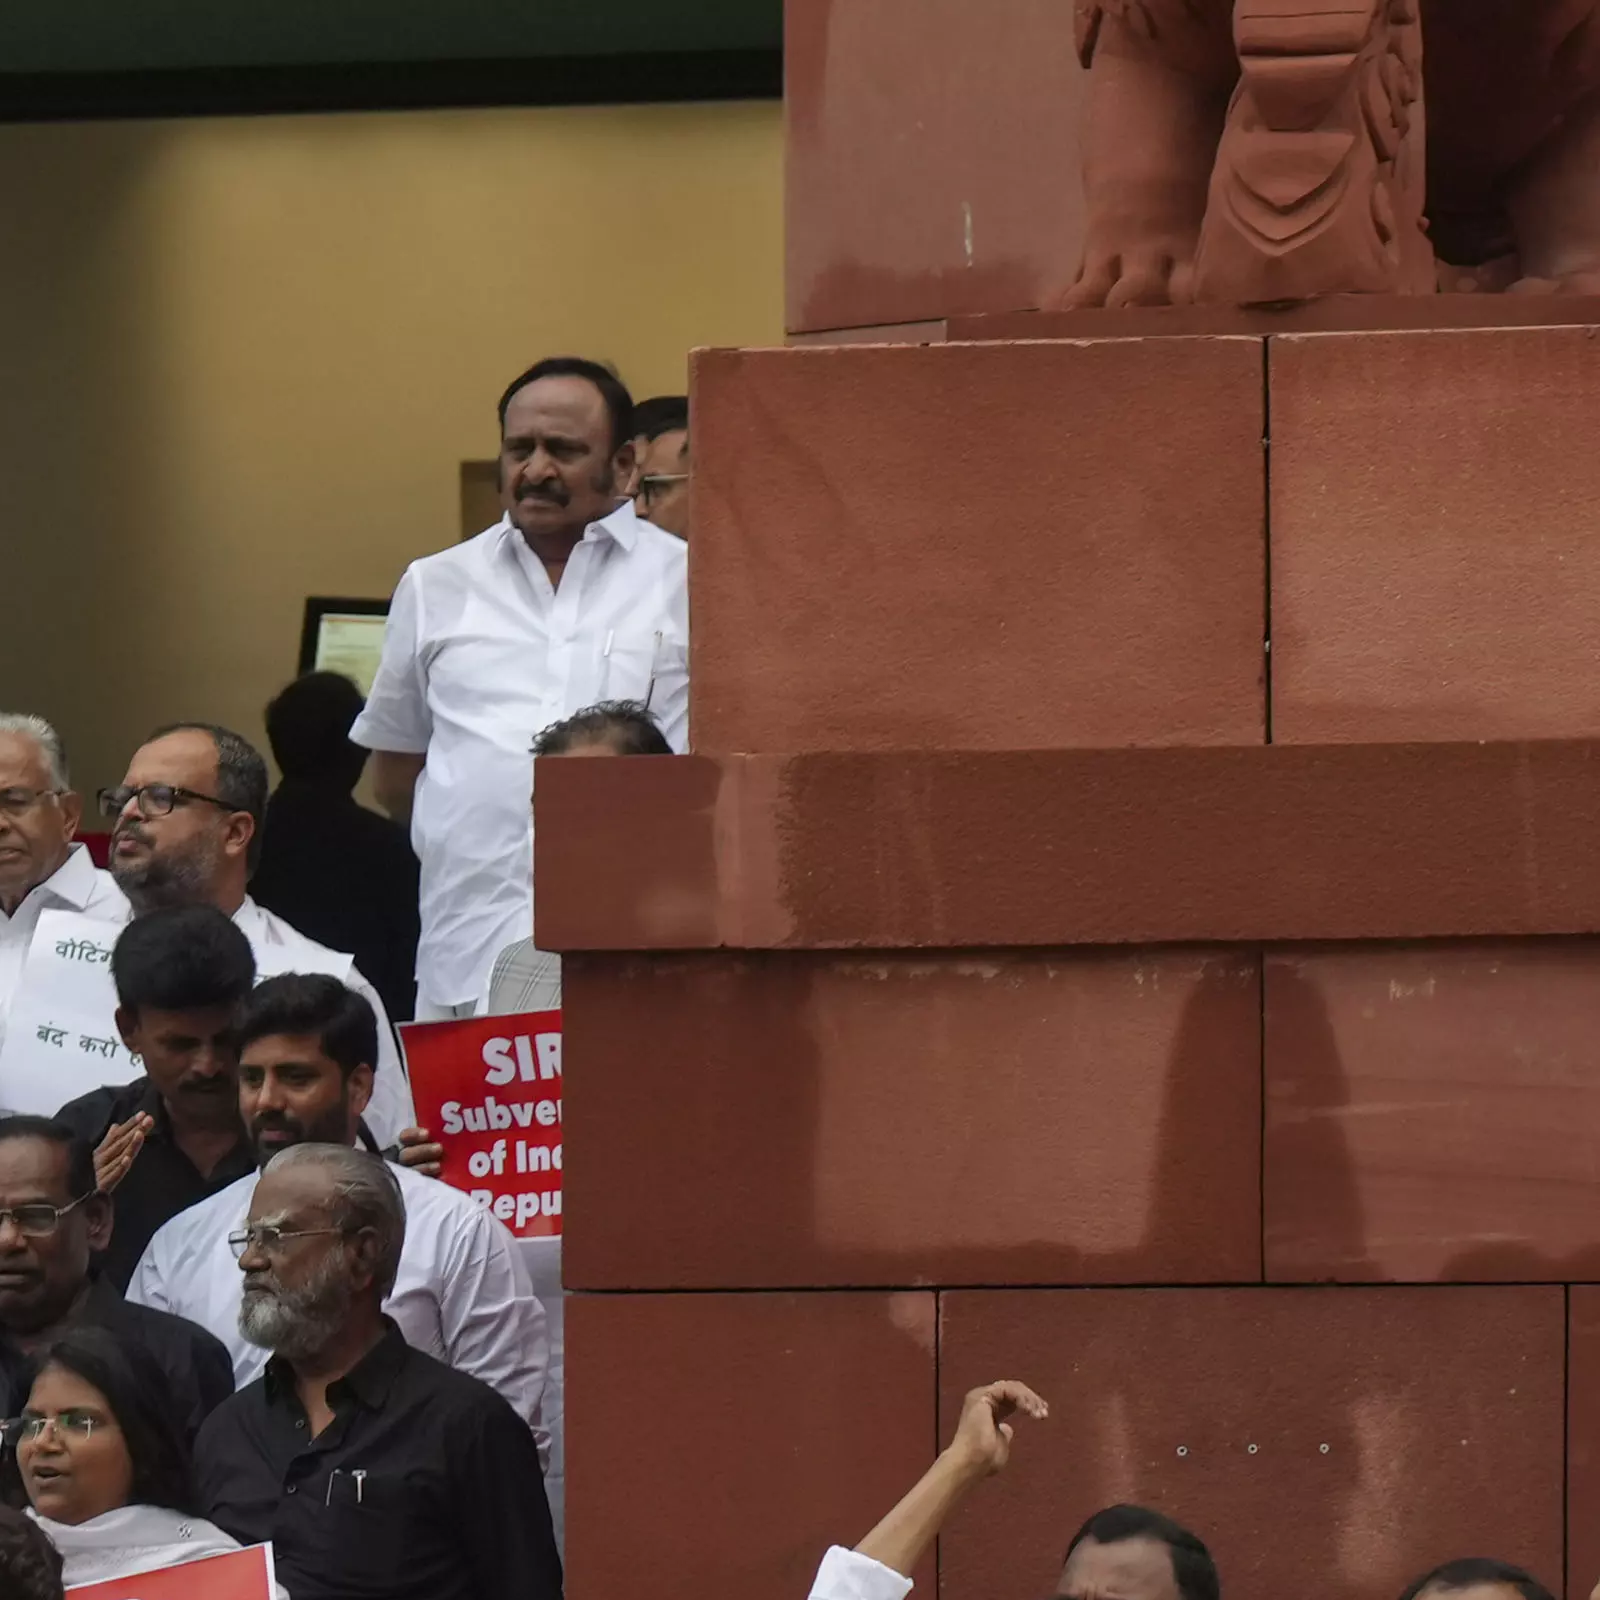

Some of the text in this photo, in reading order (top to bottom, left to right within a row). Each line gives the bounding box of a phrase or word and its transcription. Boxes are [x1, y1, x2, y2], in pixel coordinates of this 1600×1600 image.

[36, 1021, 120, 1058] बंद करो
[440, 1096, 562, 1135] Subve
[468, 1139, 507, 1178] of
